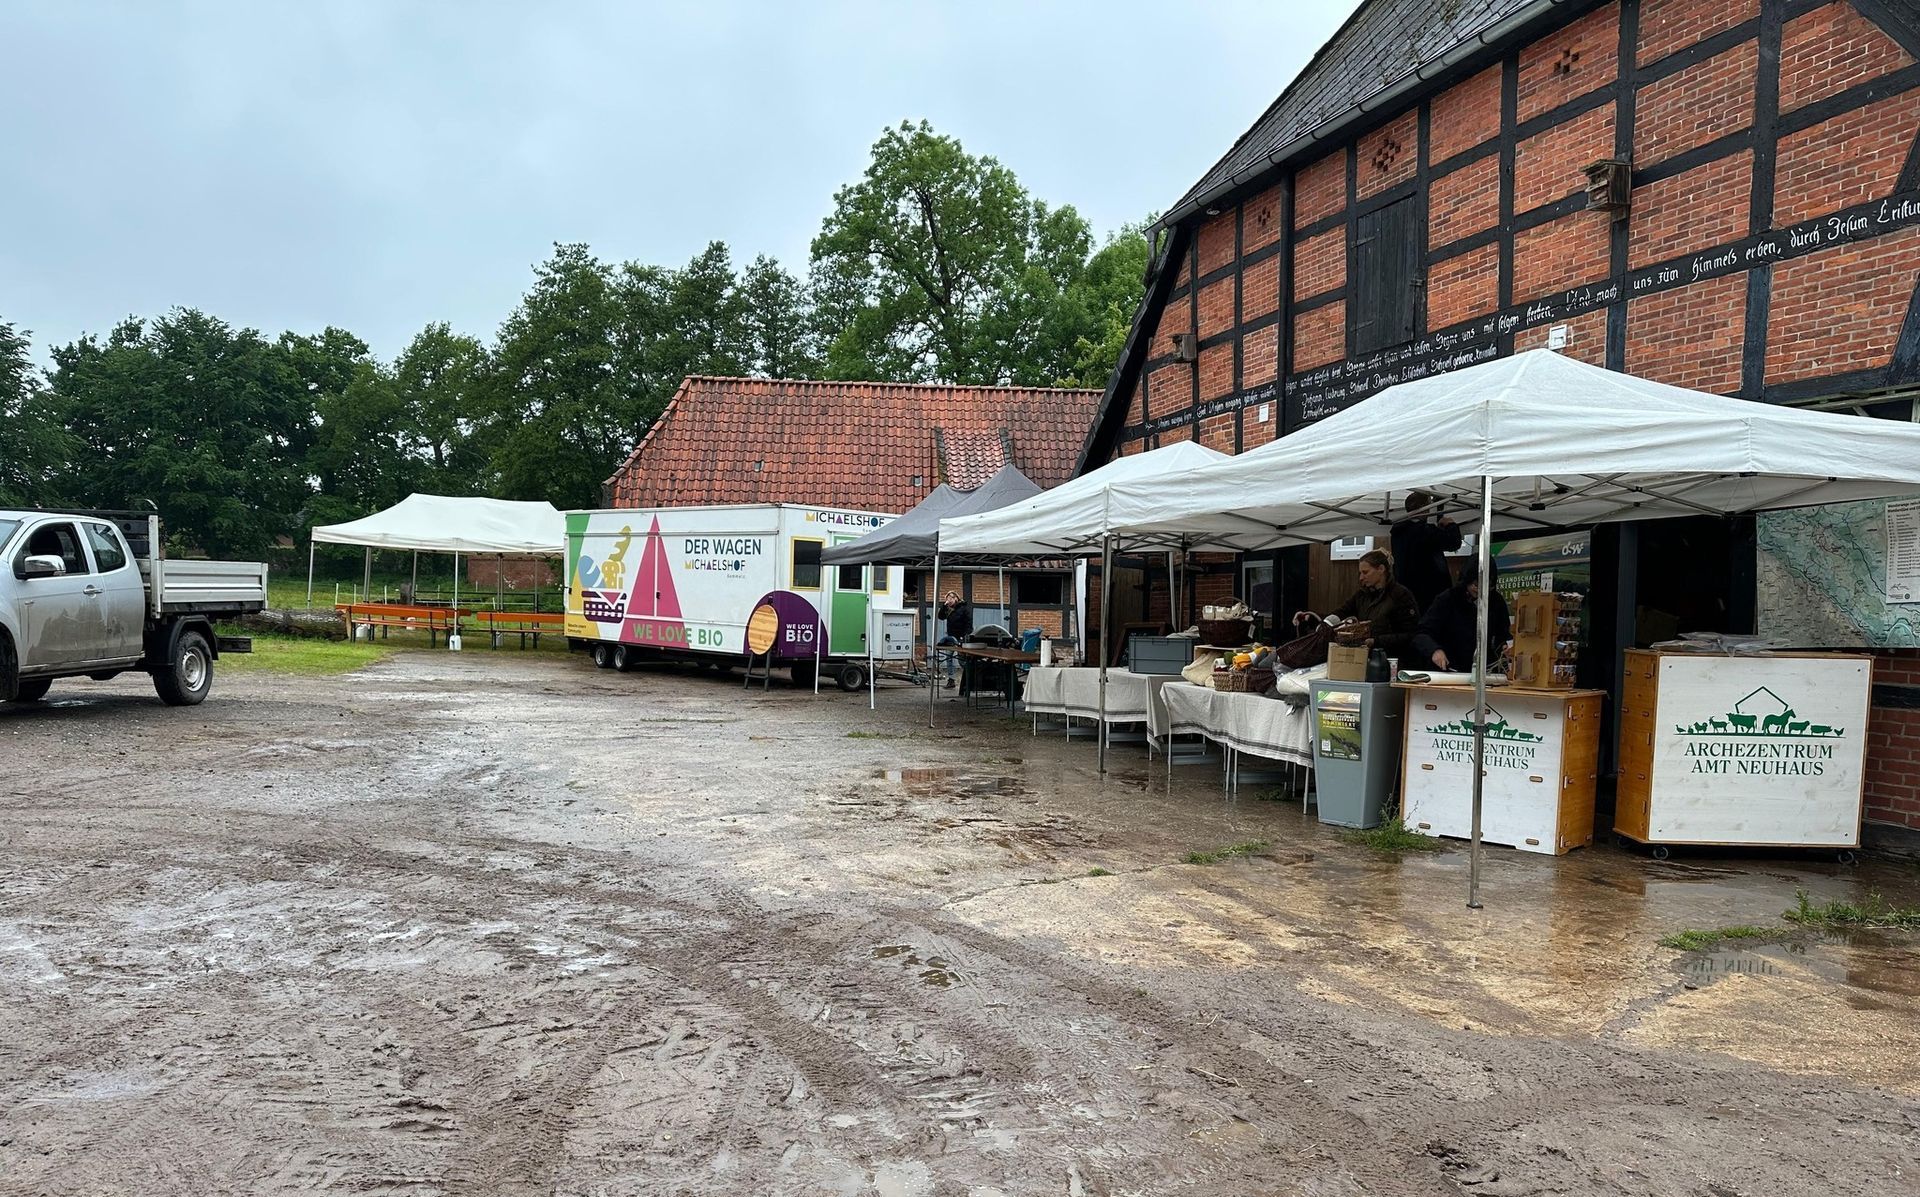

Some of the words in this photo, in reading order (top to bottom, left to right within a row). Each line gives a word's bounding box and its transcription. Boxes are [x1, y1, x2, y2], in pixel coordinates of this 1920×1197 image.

[1633, 275, 1653, 290] uns
[805, 512, 885, 527] MICHAELSHOF
[685, 539, 709, 555] DER
[712, 539, 762, 555] WAGEN
[684, 559, 746, 571] MICHAELSHOF
[633, 623, 653, 640] WE
[658, 624, 692, 643] LOVE
[698, 628, 723, 646] BIO
[1432, 738, 1536, 758] ARCHEENTRUM
[1684, 742, 1833, 759] ARCHEZENTRUM
[1436, 750, 1463, 763] AMT
[1467, 754, 1529, 770] NUHAUS
[1691, 759, 1730, 774] AMT
[1736, 760, 1824, 776] NEUHAUS
